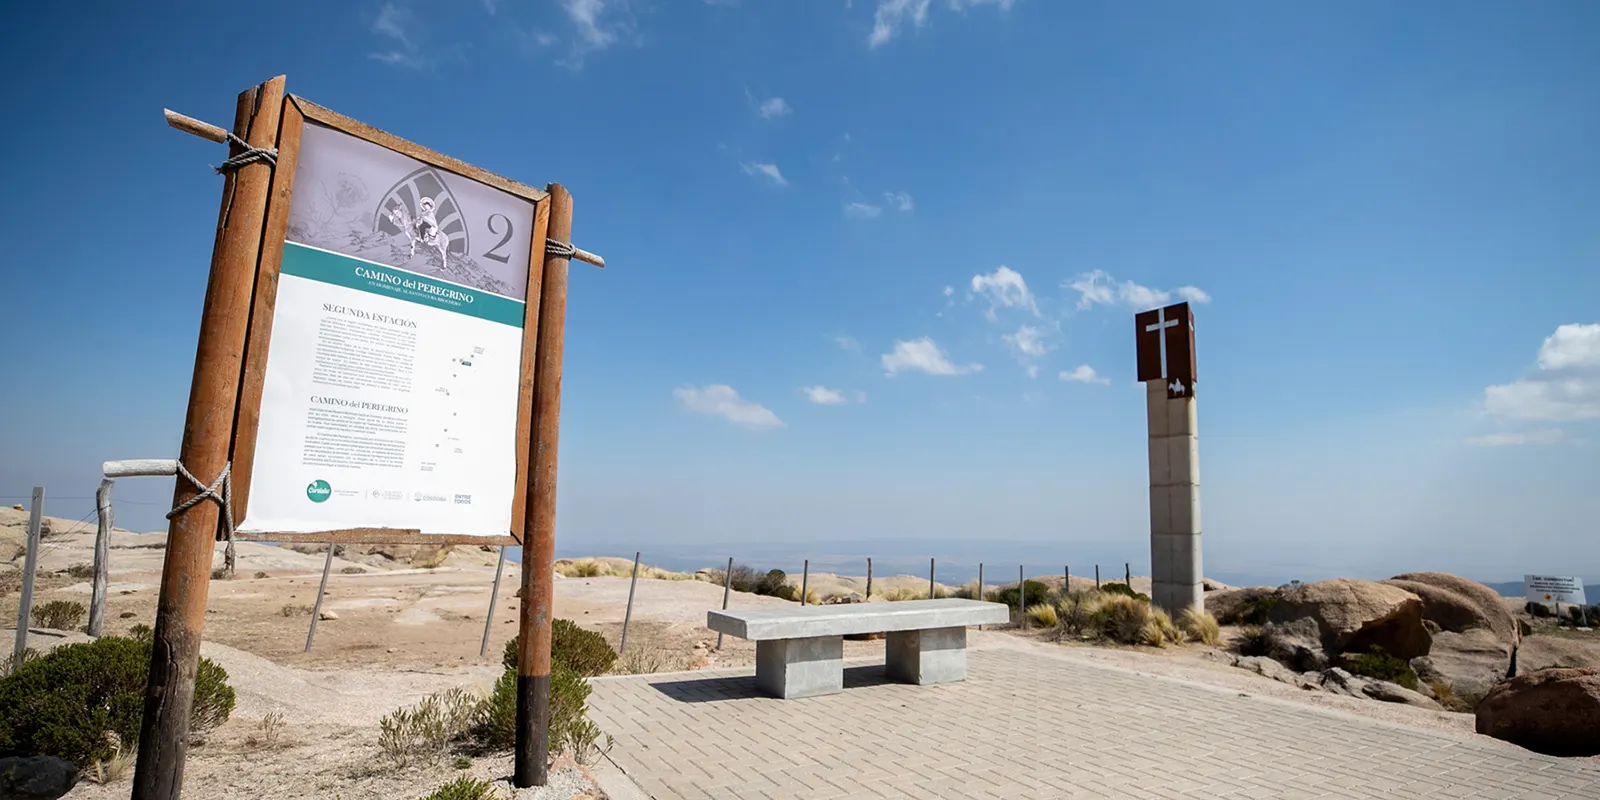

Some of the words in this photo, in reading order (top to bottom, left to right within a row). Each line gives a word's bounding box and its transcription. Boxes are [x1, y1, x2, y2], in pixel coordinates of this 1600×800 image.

[482, 213, 513, 264] 2
[355, 267, 401, 285] CAMINO
[402, 279, 416, 289] del
[417, 282, 474, 303] PEREGRINO
[322, 303, 370, 319] SEGUNDA
[371, 313, 418, 328] ESTACIÓN
[310, 395, 348, 407] CAMINO
[349, 400, 360, 408] del
[361, 402, 408, 414] PEREGRINO
